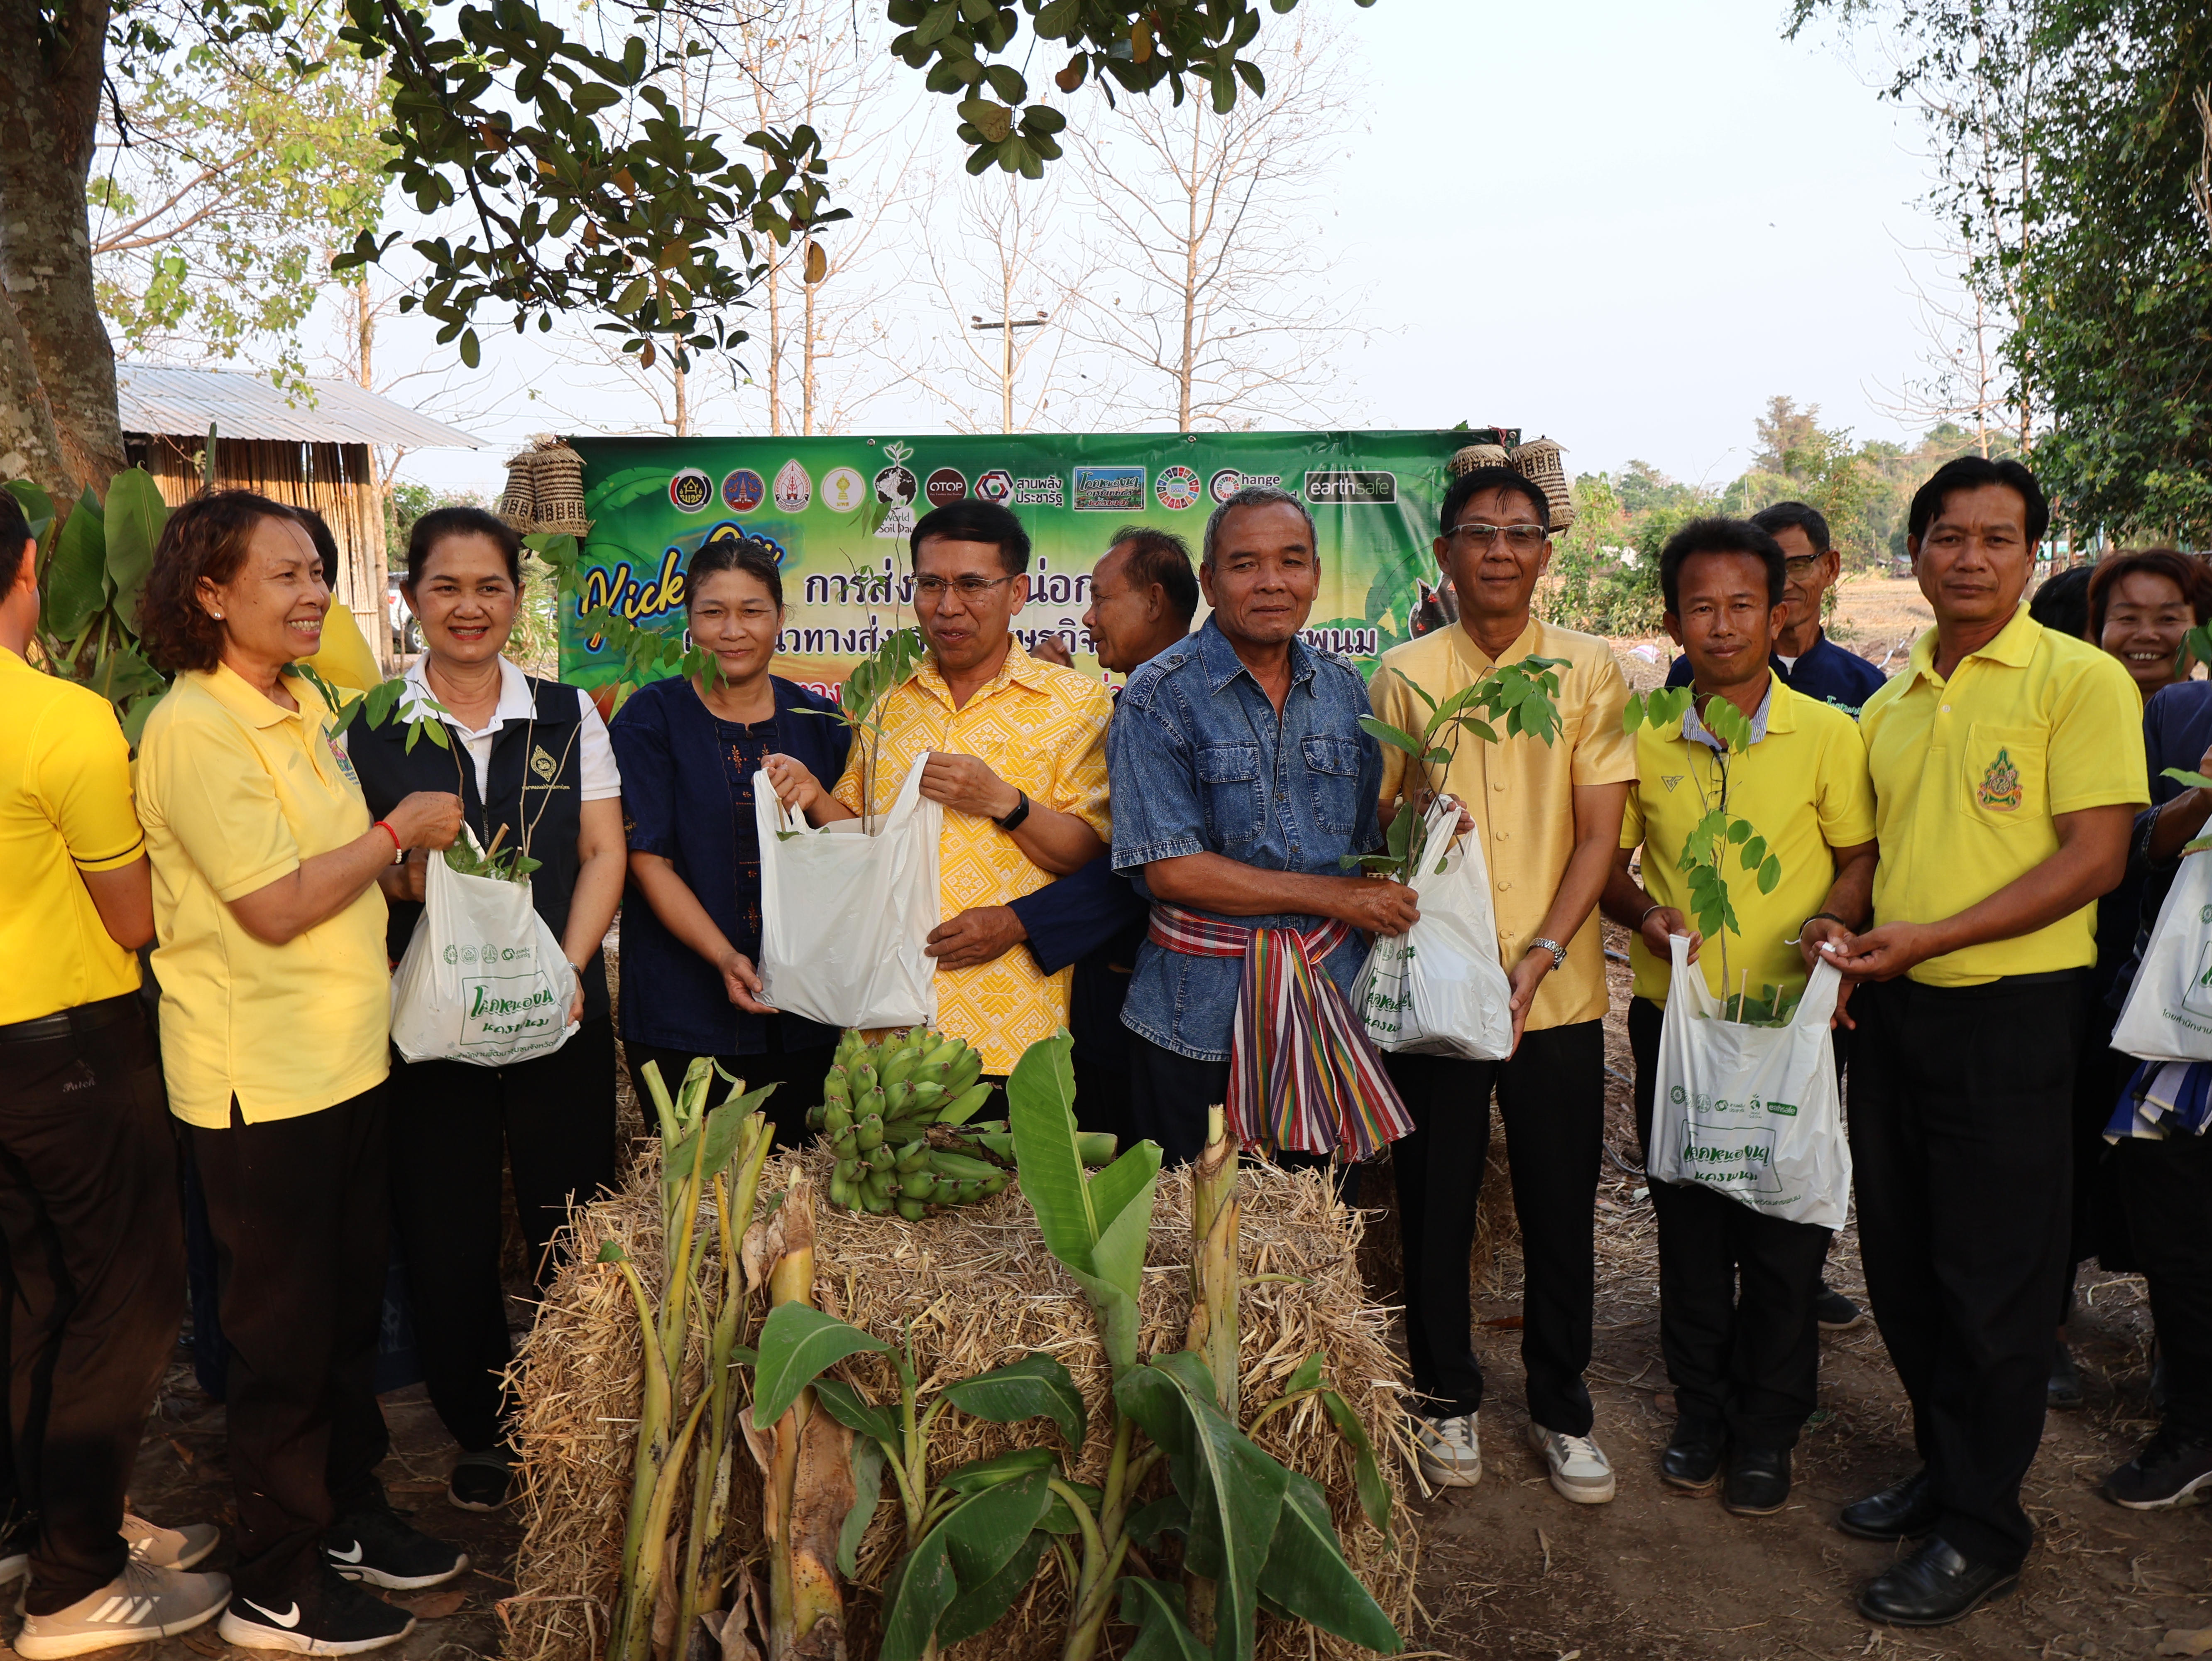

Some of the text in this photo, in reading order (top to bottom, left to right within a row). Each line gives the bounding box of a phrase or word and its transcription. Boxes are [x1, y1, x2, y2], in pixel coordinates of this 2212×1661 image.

[930, 482, 963, 491] OTOP
[1017, 476, 1062, 489] สานพลัง
[1080, 472, 1139, 490] โคกหนองนา
[1310, 478, 1390, 495] earthsafe
[1016, 491, 1062, 506] ประชารัฐ
[879, 524, 896, 533] Soil
